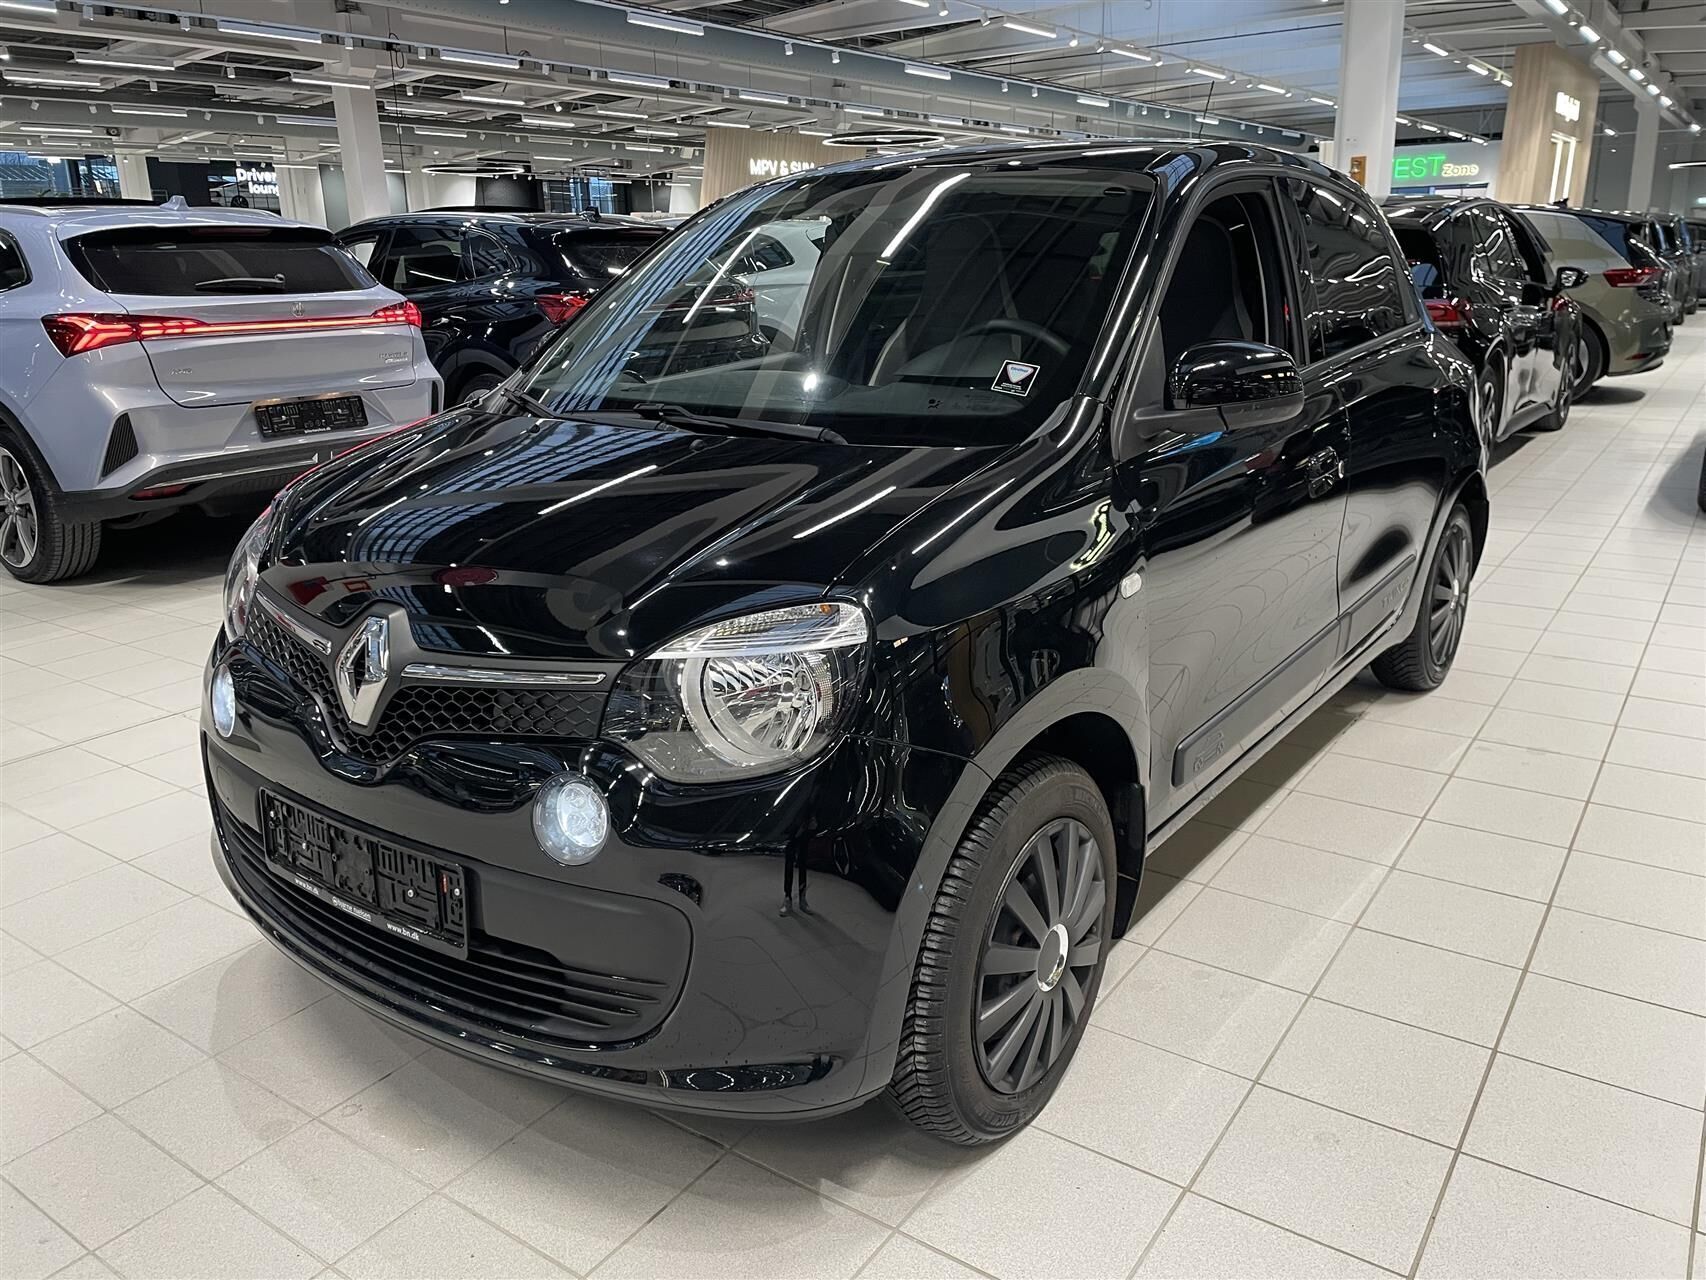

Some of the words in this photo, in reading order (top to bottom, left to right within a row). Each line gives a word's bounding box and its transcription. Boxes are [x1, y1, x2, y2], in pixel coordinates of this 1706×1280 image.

[236, 168, 277, 182] Driver
[750, 158, 777, 176] MPV
[780, 160, 789, 176] &
[1392, 154, 1446, 178] EST
[386, 922, 420, 941] www.bn.dk
